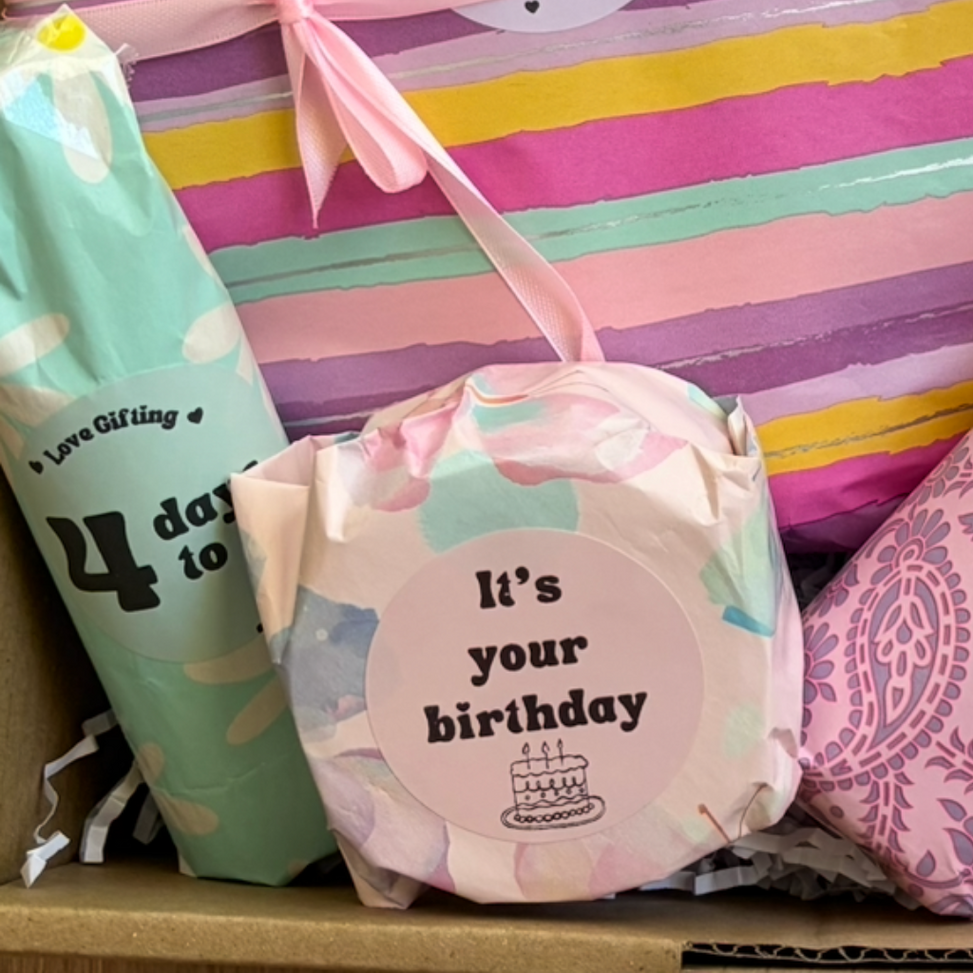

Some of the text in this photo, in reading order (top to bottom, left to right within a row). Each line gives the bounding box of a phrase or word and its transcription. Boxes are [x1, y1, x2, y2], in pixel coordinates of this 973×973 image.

[43, 405, 179, 465] Love Gifting
[46, 460, 258, 613] 4 day
[178, 542, 228, 580] to
[475, 566, 562, 609] It's
[468, 636, 588, 687] your
[424, 688, 647, 743] birthday
